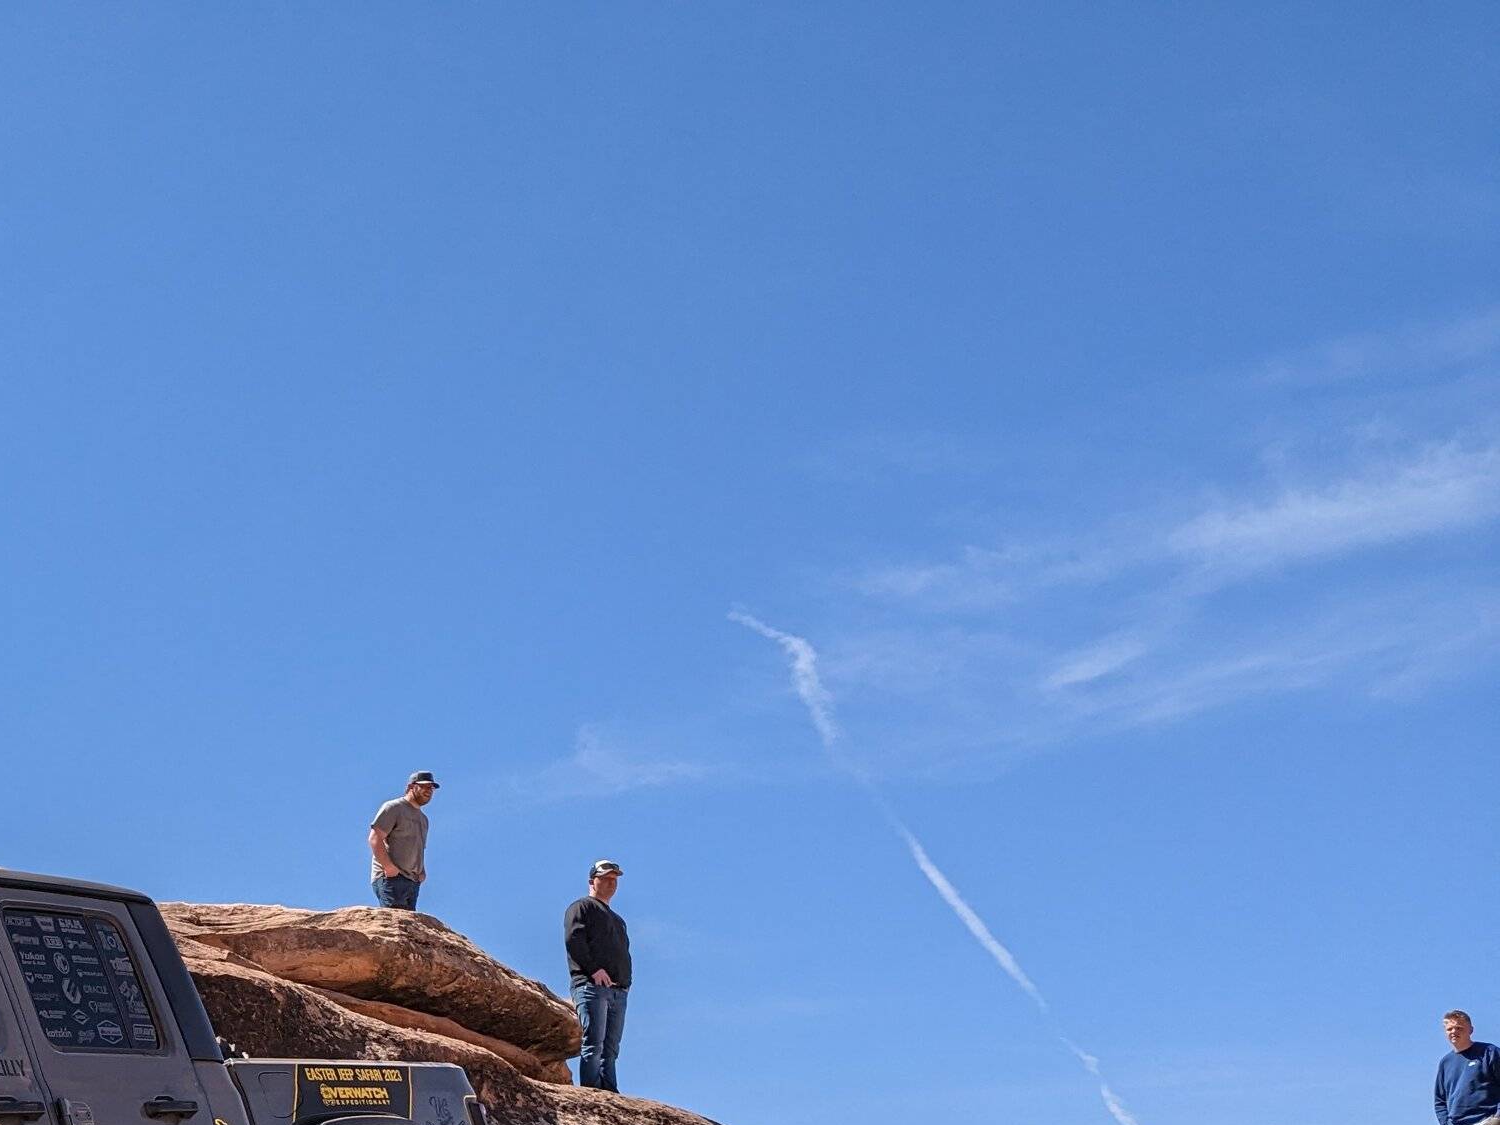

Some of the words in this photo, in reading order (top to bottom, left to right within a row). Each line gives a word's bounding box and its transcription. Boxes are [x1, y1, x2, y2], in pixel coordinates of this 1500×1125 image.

[304, 1067, 338, 1081] EASTER
[337, 1067, 354, 1081] JEEP
[355, 1068, 383, 1082] SAFARI
[382, 1069, 403, 1082] 2023
[320, 1084, 389, 1100] OVERWATCH
